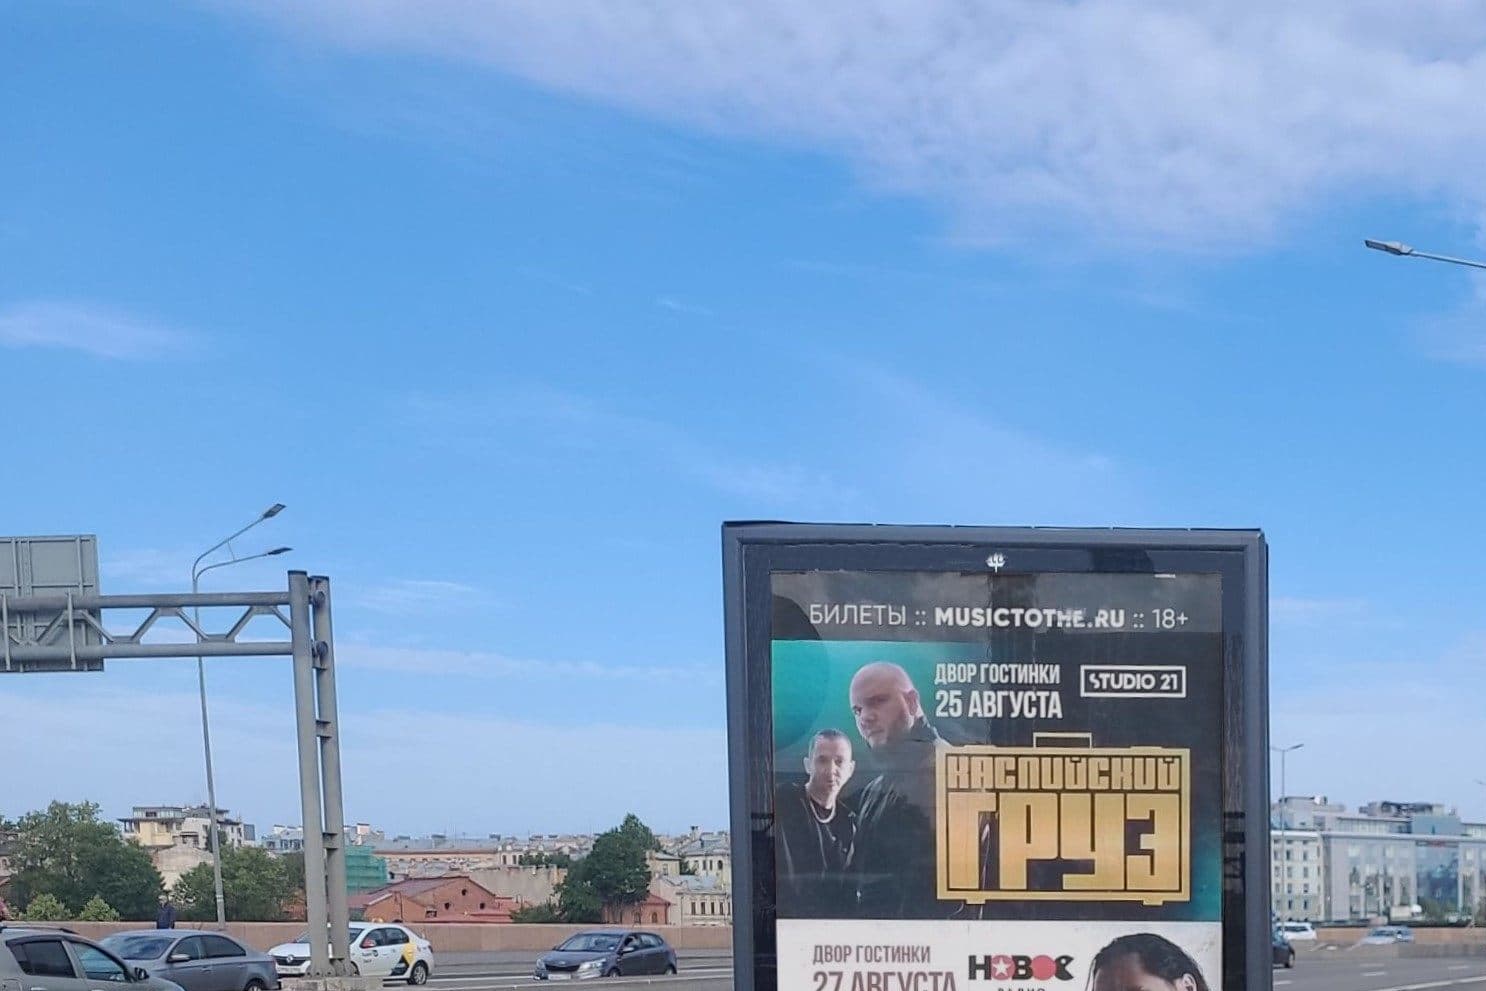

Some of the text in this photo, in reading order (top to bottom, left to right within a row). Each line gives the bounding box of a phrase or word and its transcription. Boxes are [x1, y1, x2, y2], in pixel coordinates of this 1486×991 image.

[809, 603, 906, 626] БИЛЕТЫ
[934, 606, 1126, 629] MUSICTOTHE.RU
[1151, 607, 1189, 630] 18+
[934, 662, 1061, 685] ДВОР ГОСТИНКИ
[1088, 672, 1179, 691] STUDIO 21
[934, 689, 1064, 719] 25 АВГУСТА
[947, 755, 1181, 790] КАСПИЙСКИЙ
[947, 790, 1181, 891] ГРУЗ
[812, 944, 932, 964] ДВОР ГОСТИНКИ
